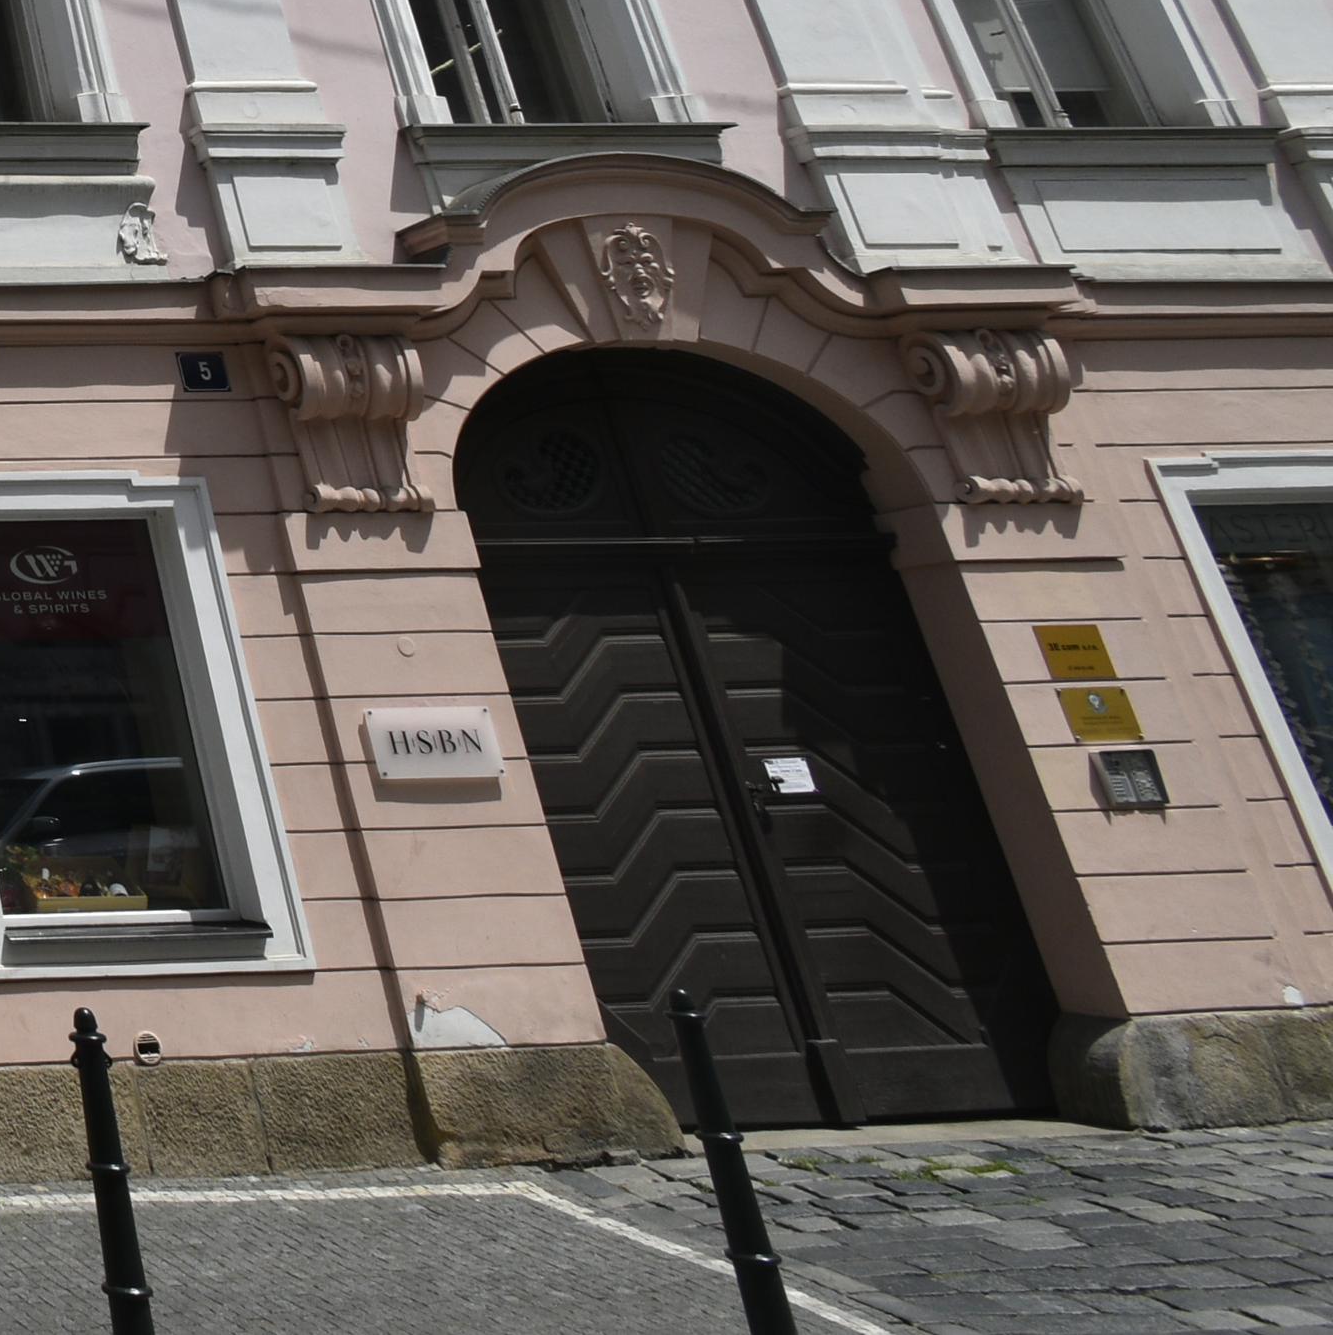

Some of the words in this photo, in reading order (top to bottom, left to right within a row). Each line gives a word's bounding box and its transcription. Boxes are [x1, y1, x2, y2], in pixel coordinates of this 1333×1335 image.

[197, 361, 212, 381] 5
[56, 589, 108, 600] WINES
[13, 604, 23, 615] &
[28, 603, 90, 614] SPIRITS
